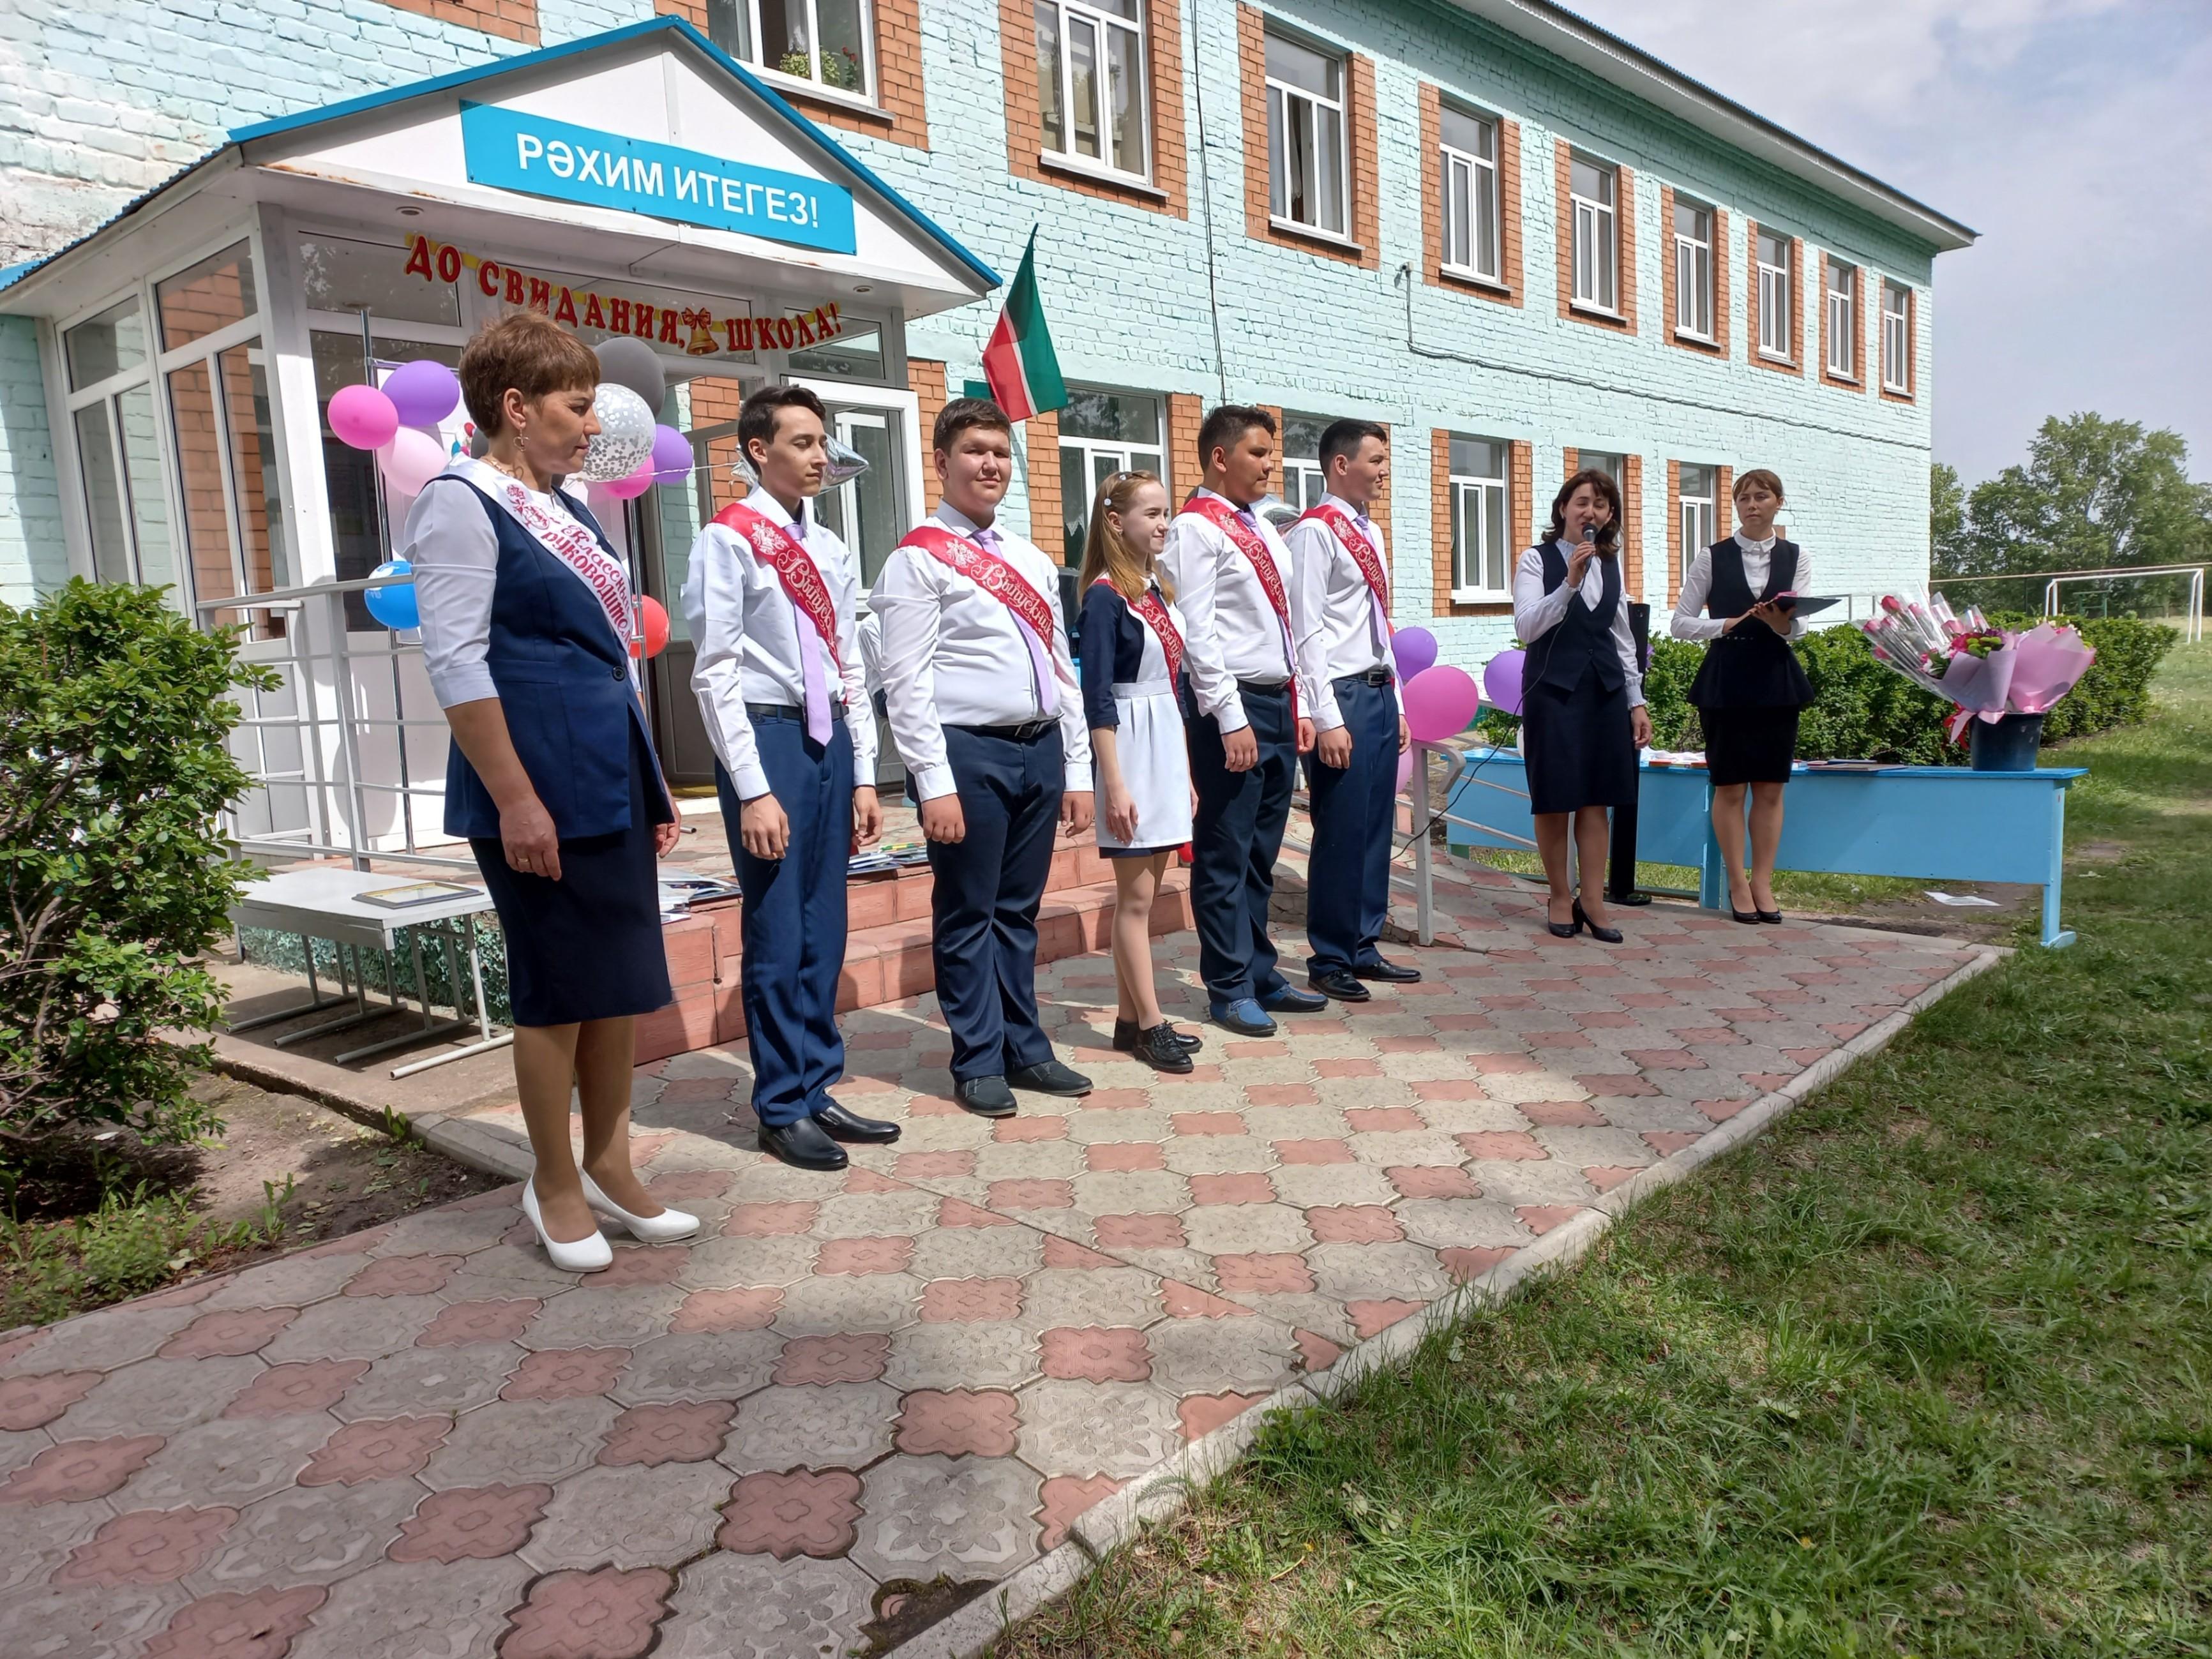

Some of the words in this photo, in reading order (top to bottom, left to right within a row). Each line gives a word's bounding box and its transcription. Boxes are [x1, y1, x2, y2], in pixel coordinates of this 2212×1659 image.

[516, 131, 665, 197] РӘХИМ
[673, 165, 820, 229] ИТЕГЕЗ!
[405, 234, 463, 283] ДО
[478, 260, 685, 349] СВИДАНИЯ,
[725, 301, 841, 353] ШКОЛА!
